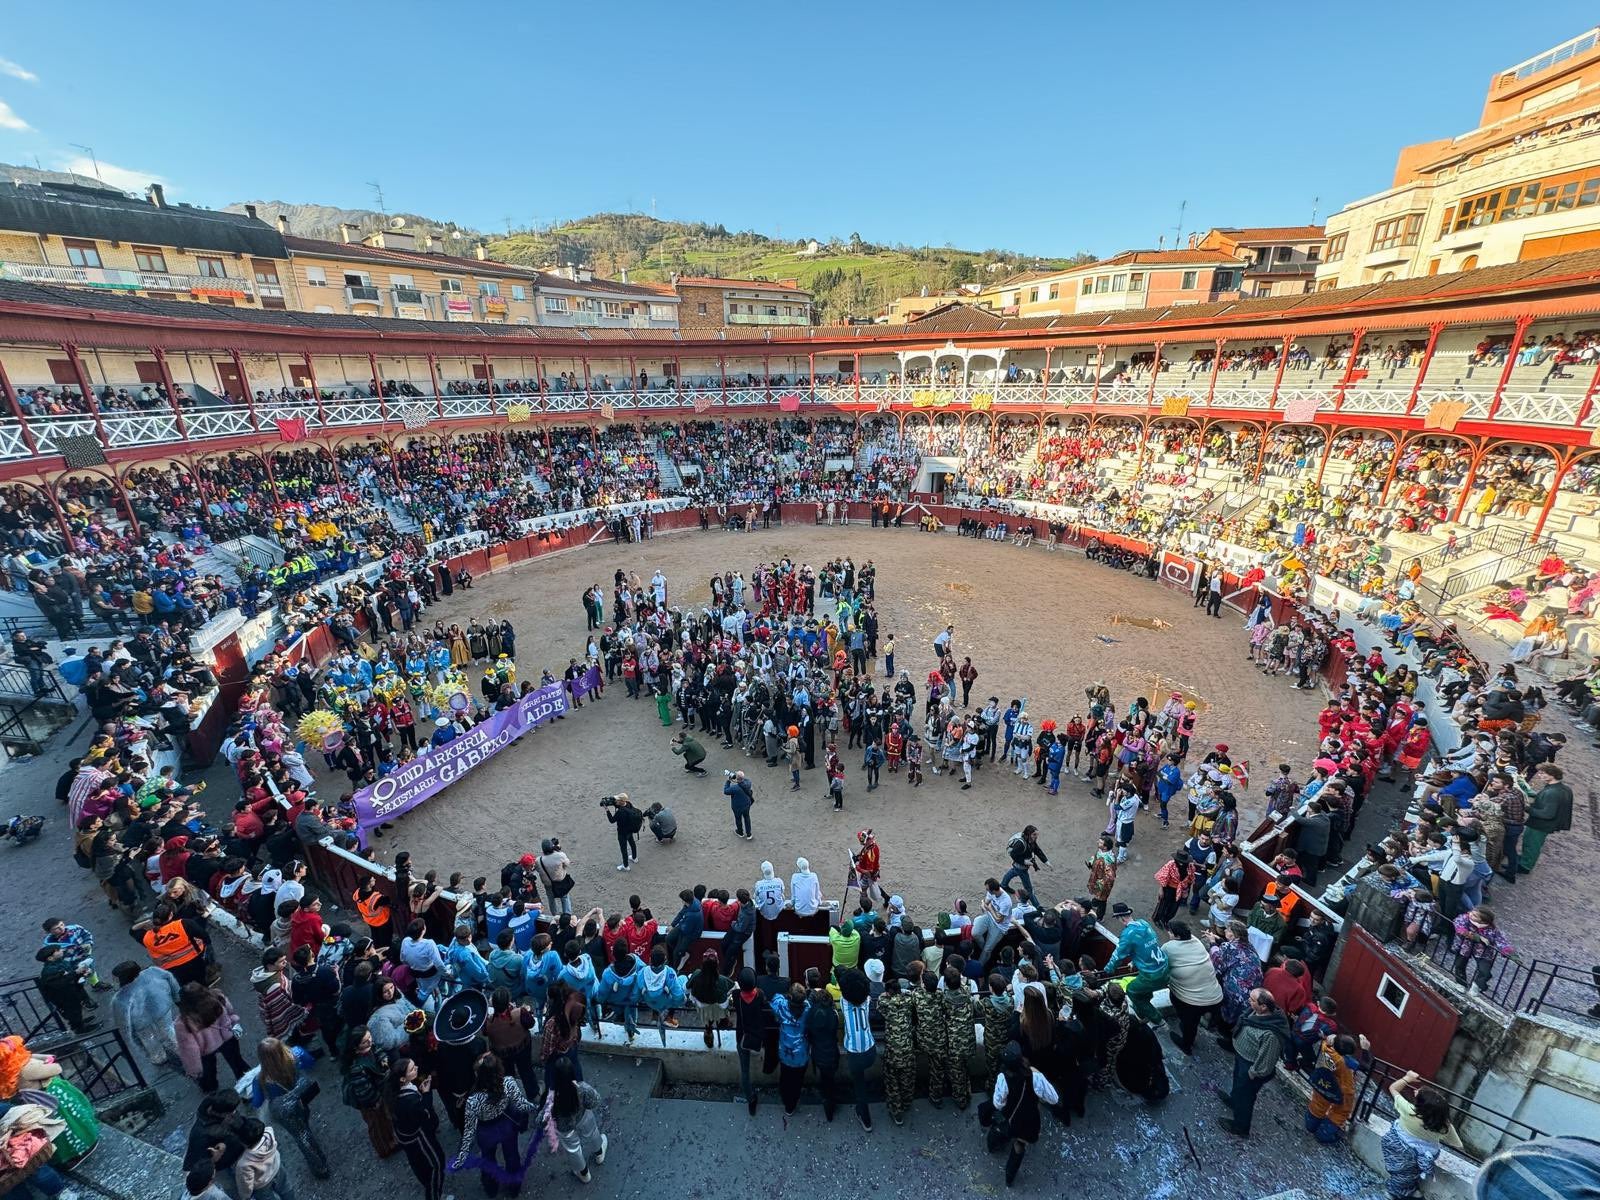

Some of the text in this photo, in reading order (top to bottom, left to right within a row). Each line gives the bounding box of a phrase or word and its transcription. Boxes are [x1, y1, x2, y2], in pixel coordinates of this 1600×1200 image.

[526, 698, 564, 724] ALDE
[397, 729, 488, 788] INDARKERIA
[376, 730, 509, 817] SEXISTARIK GABEKO
[766, 890, 775, 905] 5
[853, 1007, 867, 1031] 10
